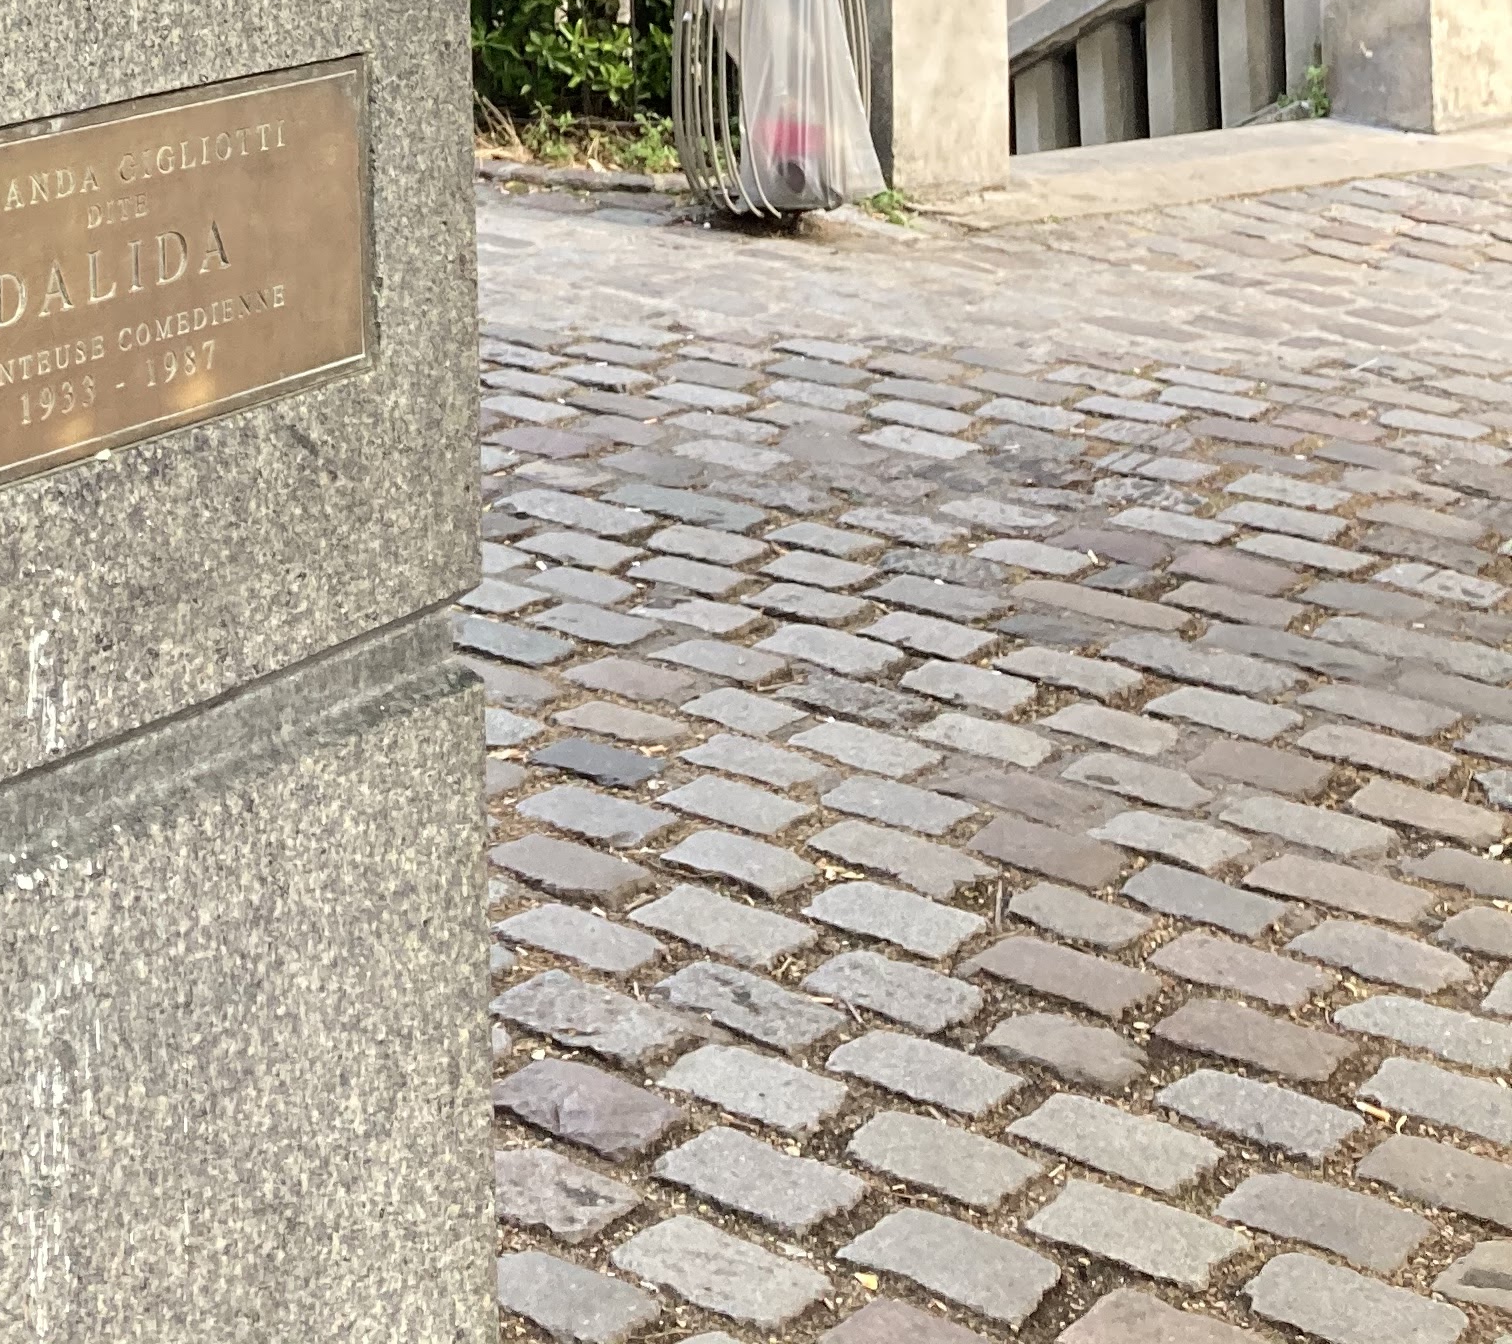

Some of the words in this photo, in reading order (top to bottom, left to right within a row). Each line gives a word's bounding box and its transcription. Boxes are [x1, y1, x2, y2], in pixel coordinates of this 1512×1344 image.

[118, 122, 287, 183] GIGLIOTTI
[86, 192, 149, 229] DITE
[118, 284, 286, 353] COMEDIENNE
[19, 374, 96, 425] 1933
[146, 339, 217, 388] 1987
